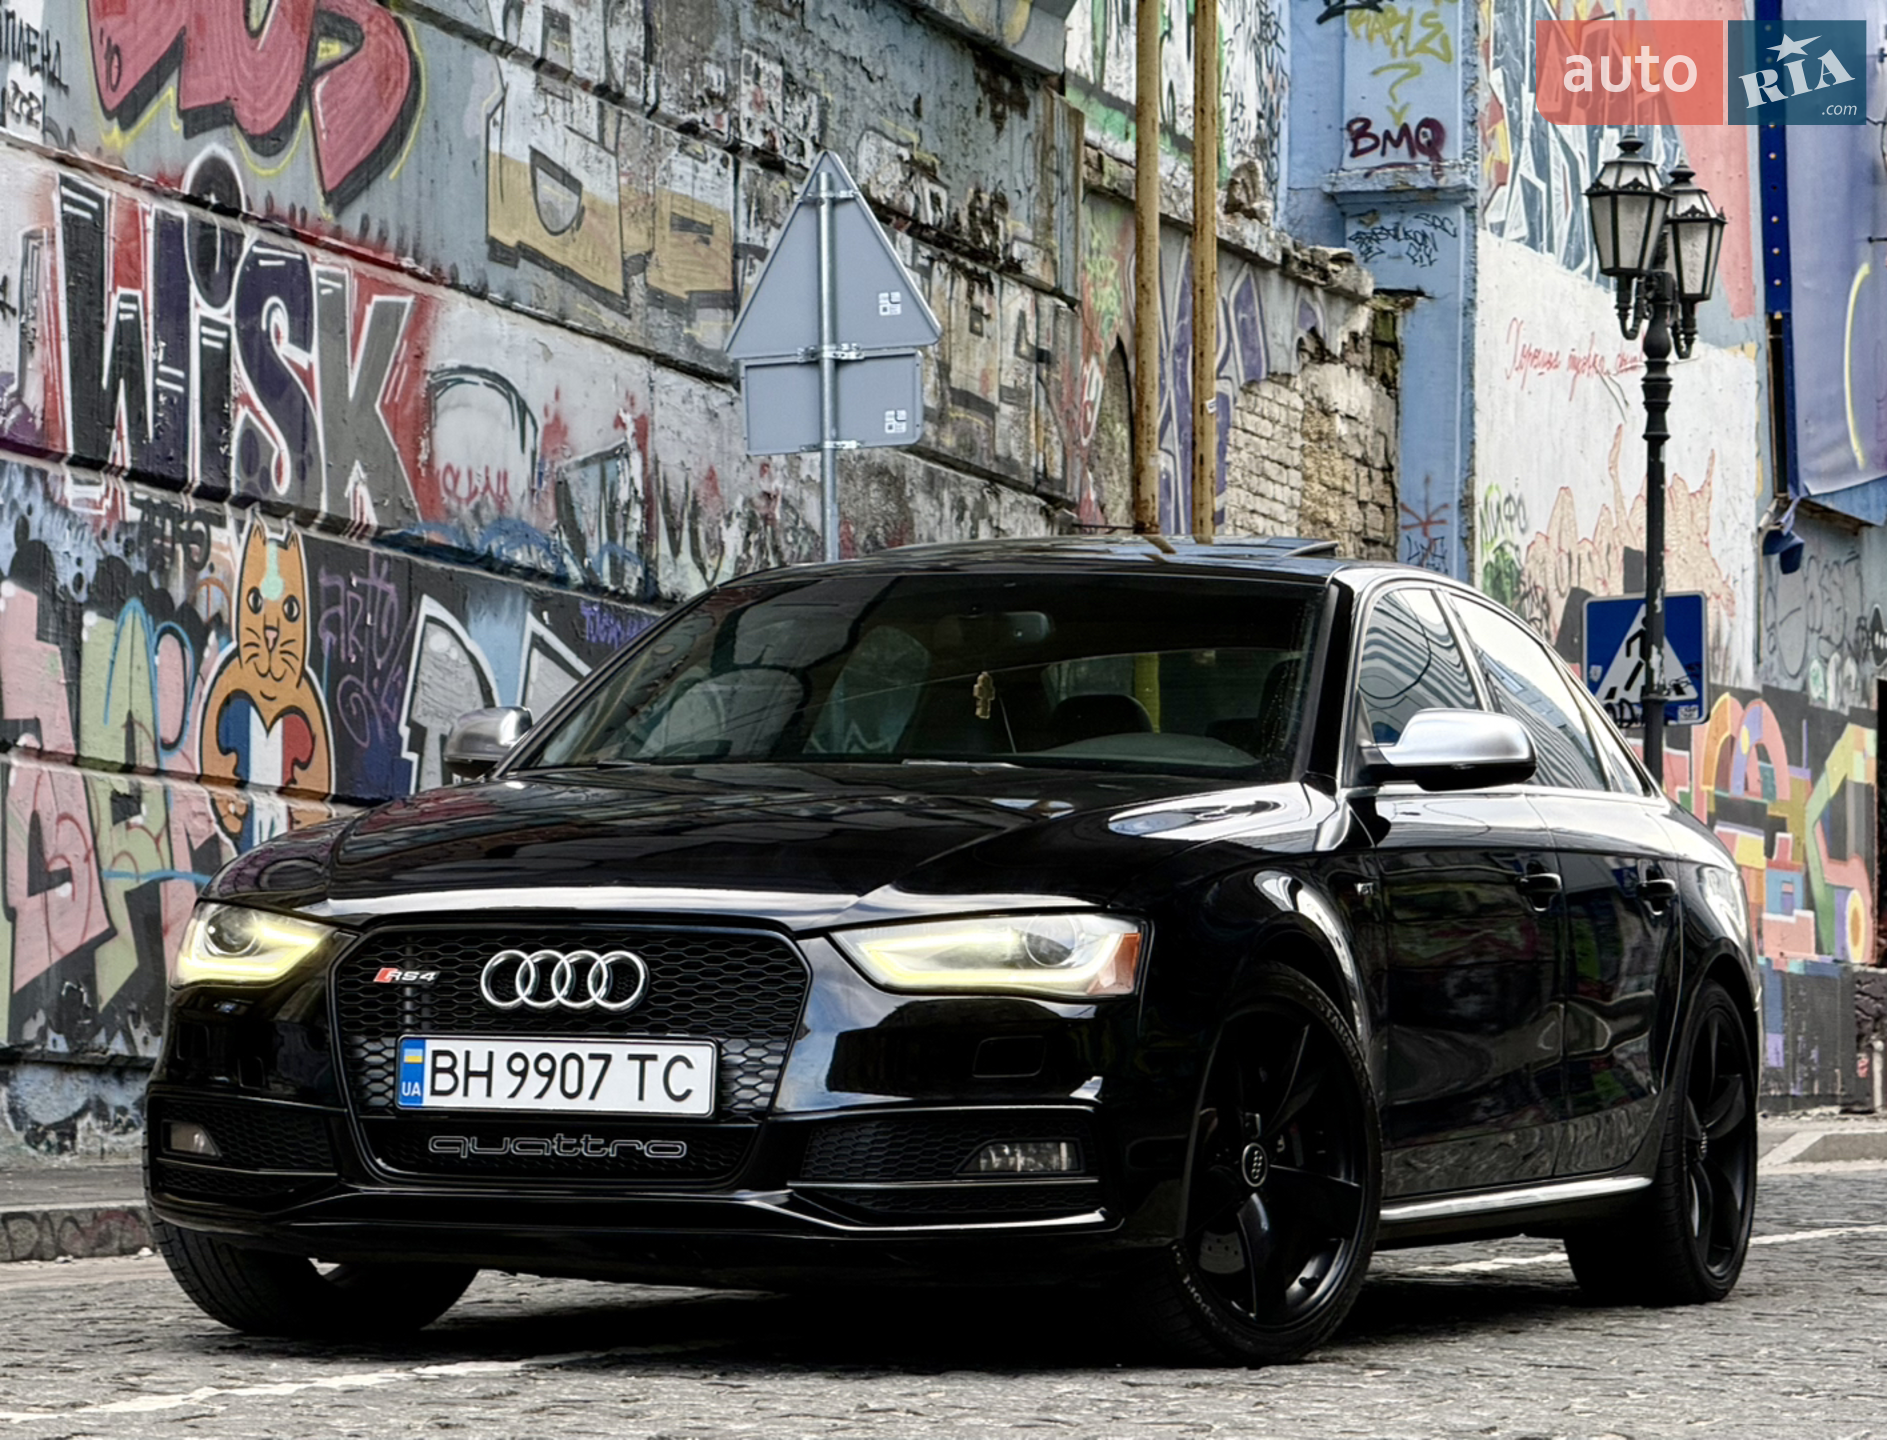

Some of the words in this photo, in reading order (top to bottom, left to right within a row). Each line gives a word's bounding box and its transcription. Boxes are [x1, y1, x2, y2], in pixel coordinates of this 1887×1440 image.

[381, 969, 439, 982] RS4
[430, 1050, 494, 1097] BH
[506, 1052, 612, 1100] 9907
[627, 1053, 694, 1102] TC
[401, 1081, 422, 1097] UA
[428, 1133, 687, 1158] quattro
